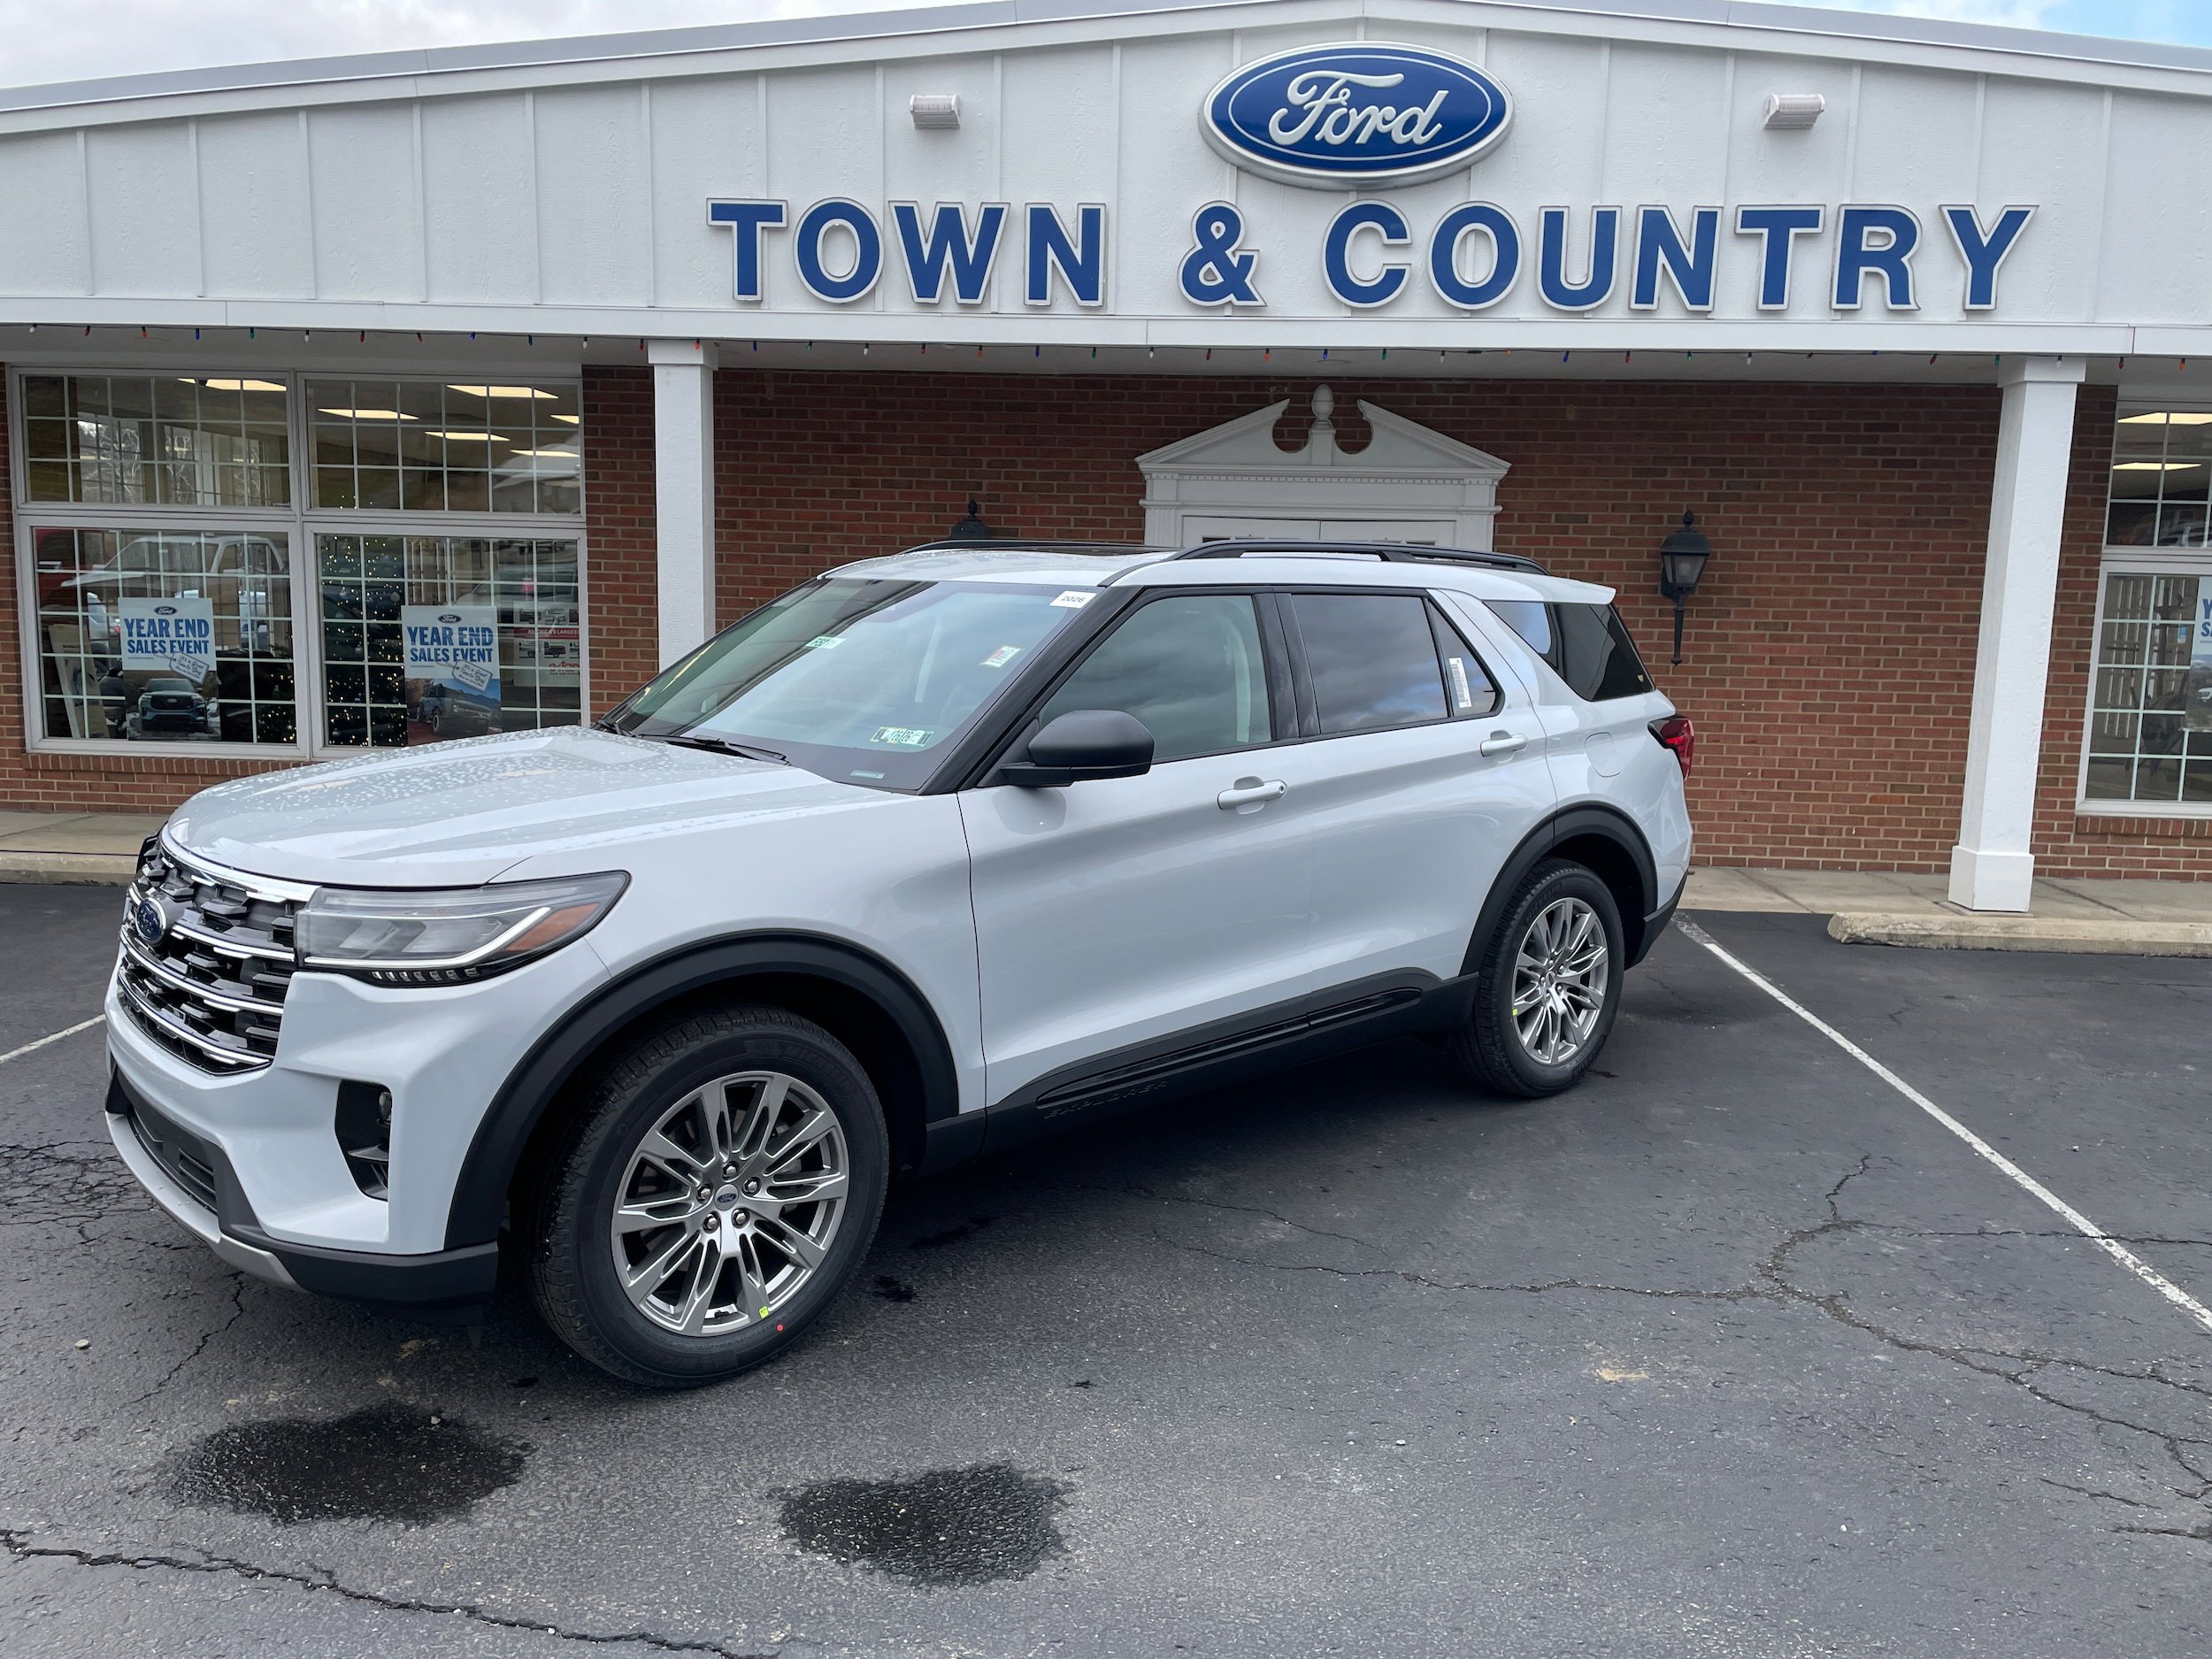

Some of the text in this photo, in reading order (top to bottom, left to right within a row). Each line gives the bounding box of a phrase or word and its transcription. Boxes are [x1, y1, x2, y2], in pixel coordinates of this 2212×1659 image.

[1269, 70, 1449, 145] Ford
[707, 196, 2039, 311] TOWN & COUNTRY
[157, 606, 173, 615] Ford
[124, 618, 210, 638] YEAR END
[407, 626, 494, 646] YEAR END
[127, 640, 210, 654] SALES EVENT
[410, 648, 493, 663] SALES EVENT
[1043, 1080, 1169, 1119] EXPLORER
